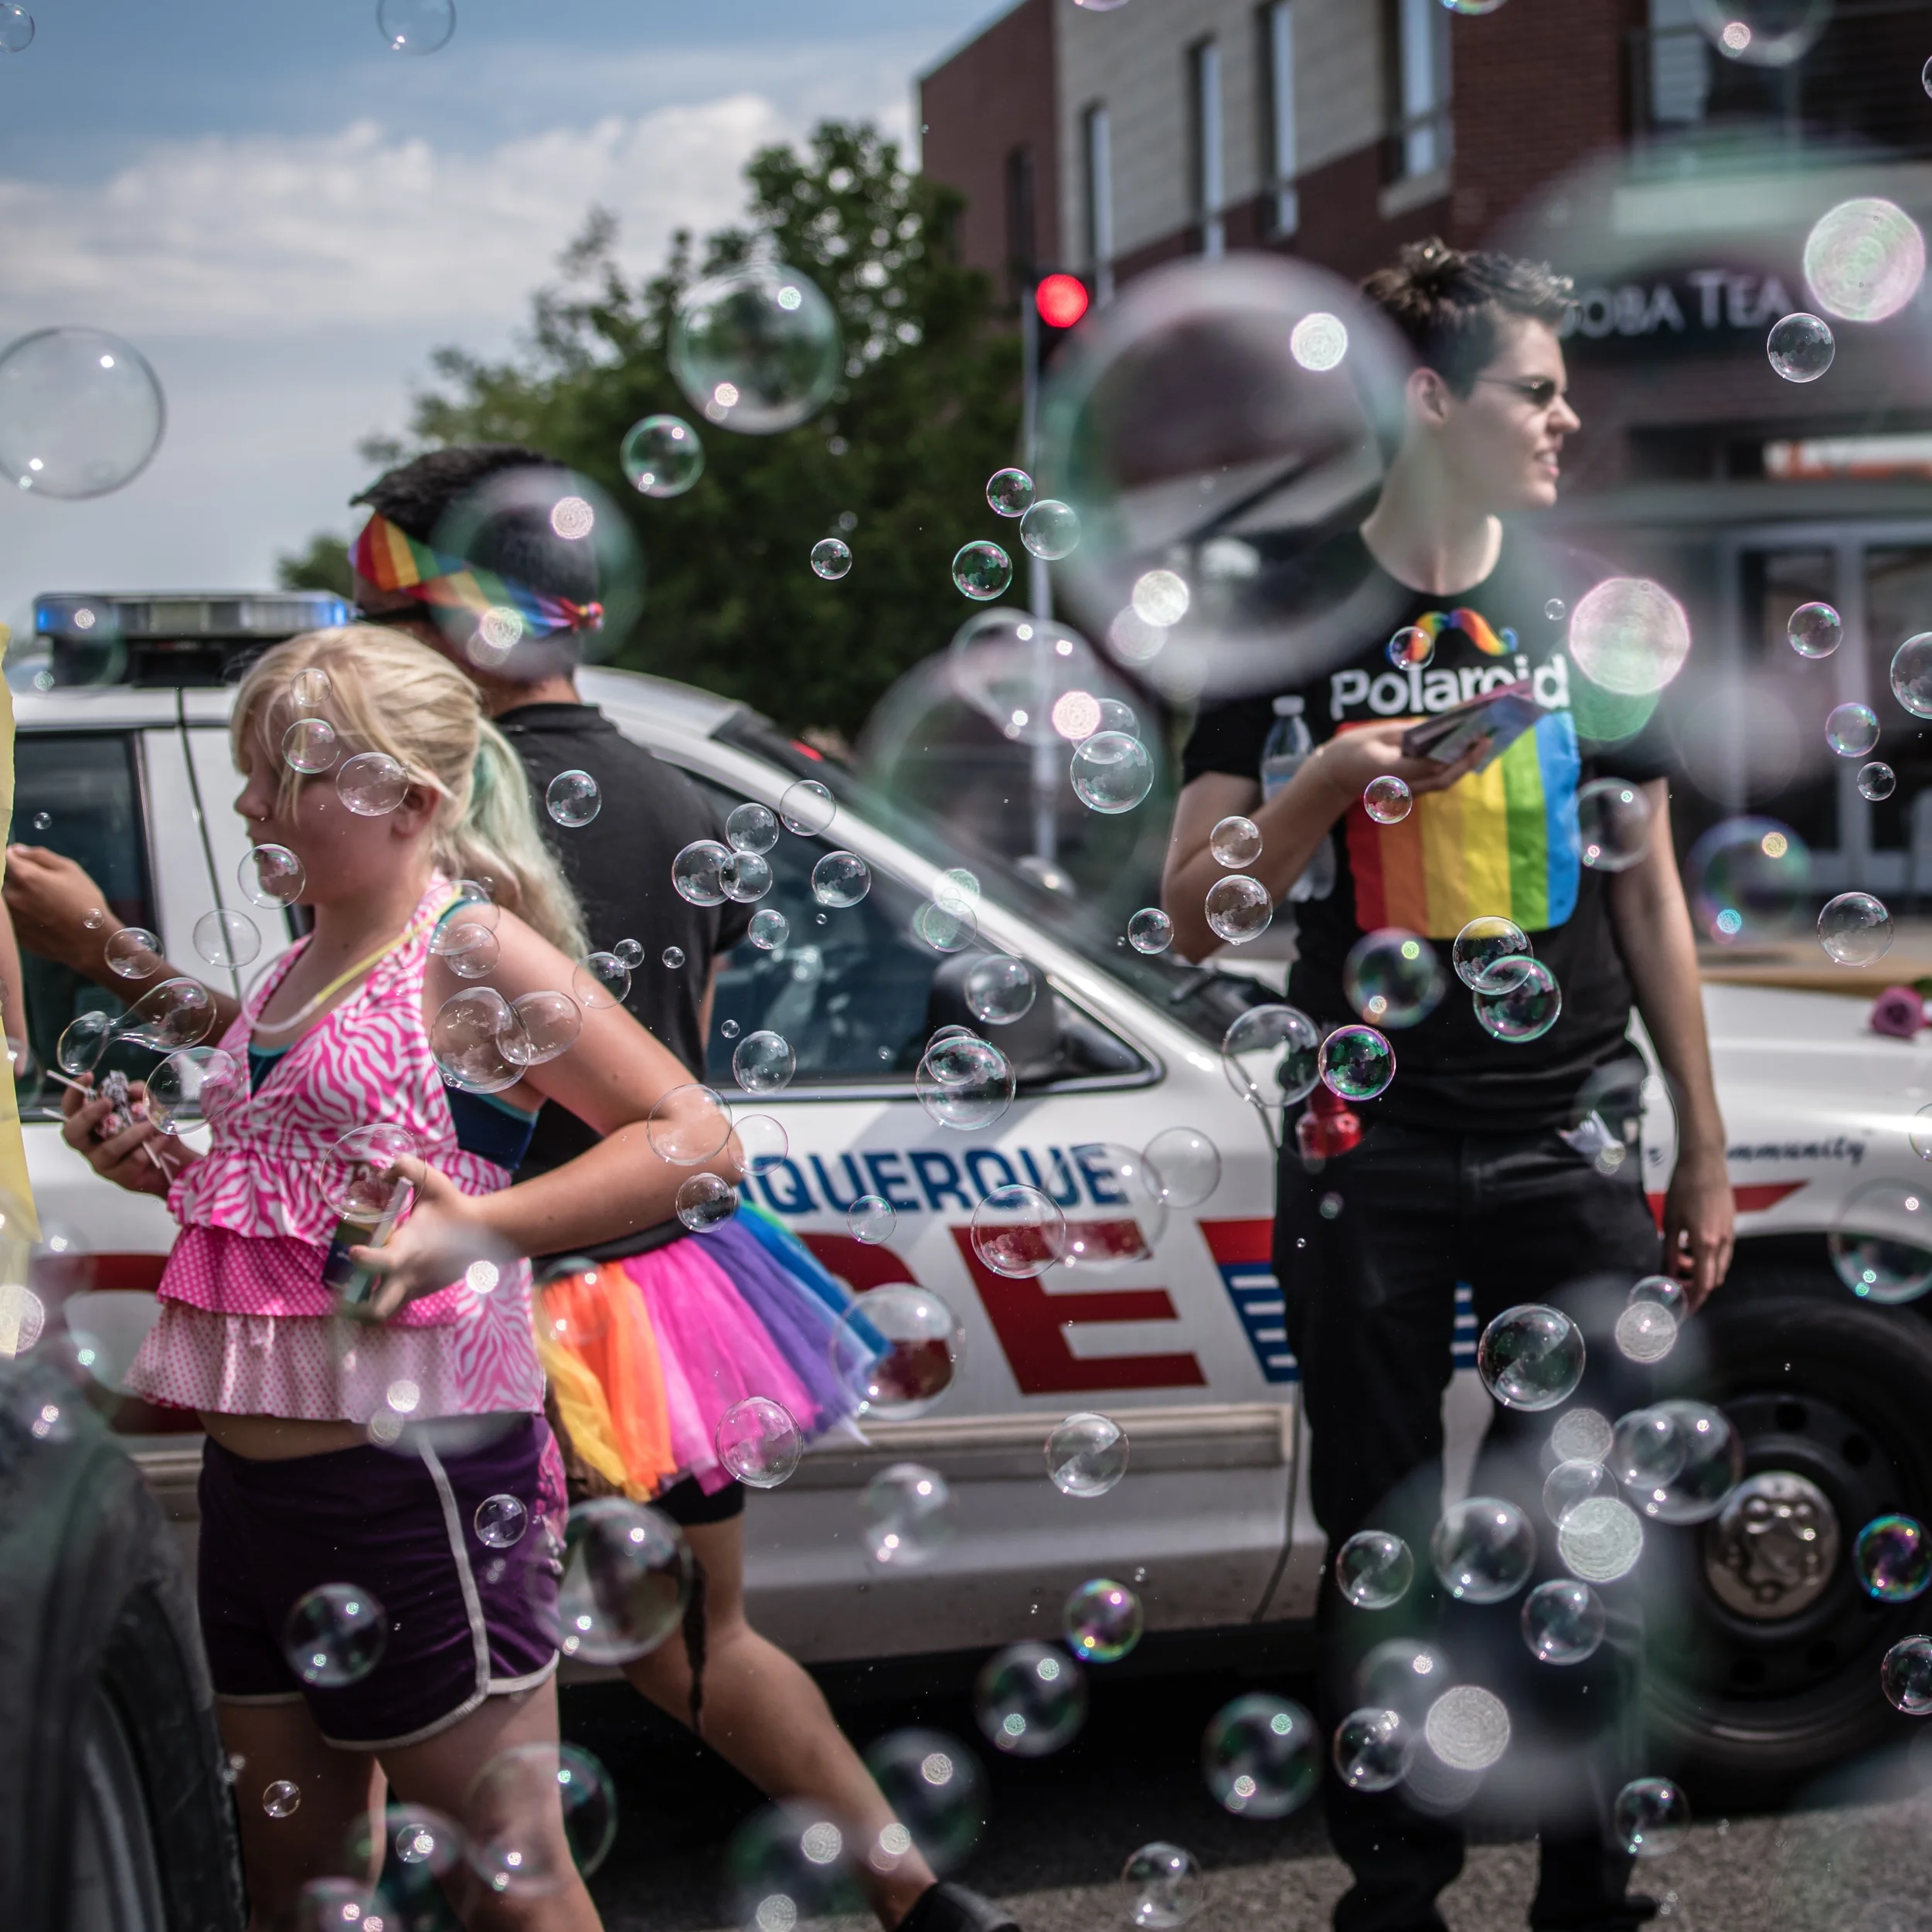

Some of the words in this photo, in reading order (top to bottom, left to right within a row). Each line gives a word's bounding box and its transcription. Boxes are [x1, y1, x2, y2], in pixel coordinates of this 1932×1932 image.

[1688, 270, 1794, 329] TEA
[1330, 654, 1570, 720] Polaroid
[1727, 1134, 1865, 1167] mmunity
